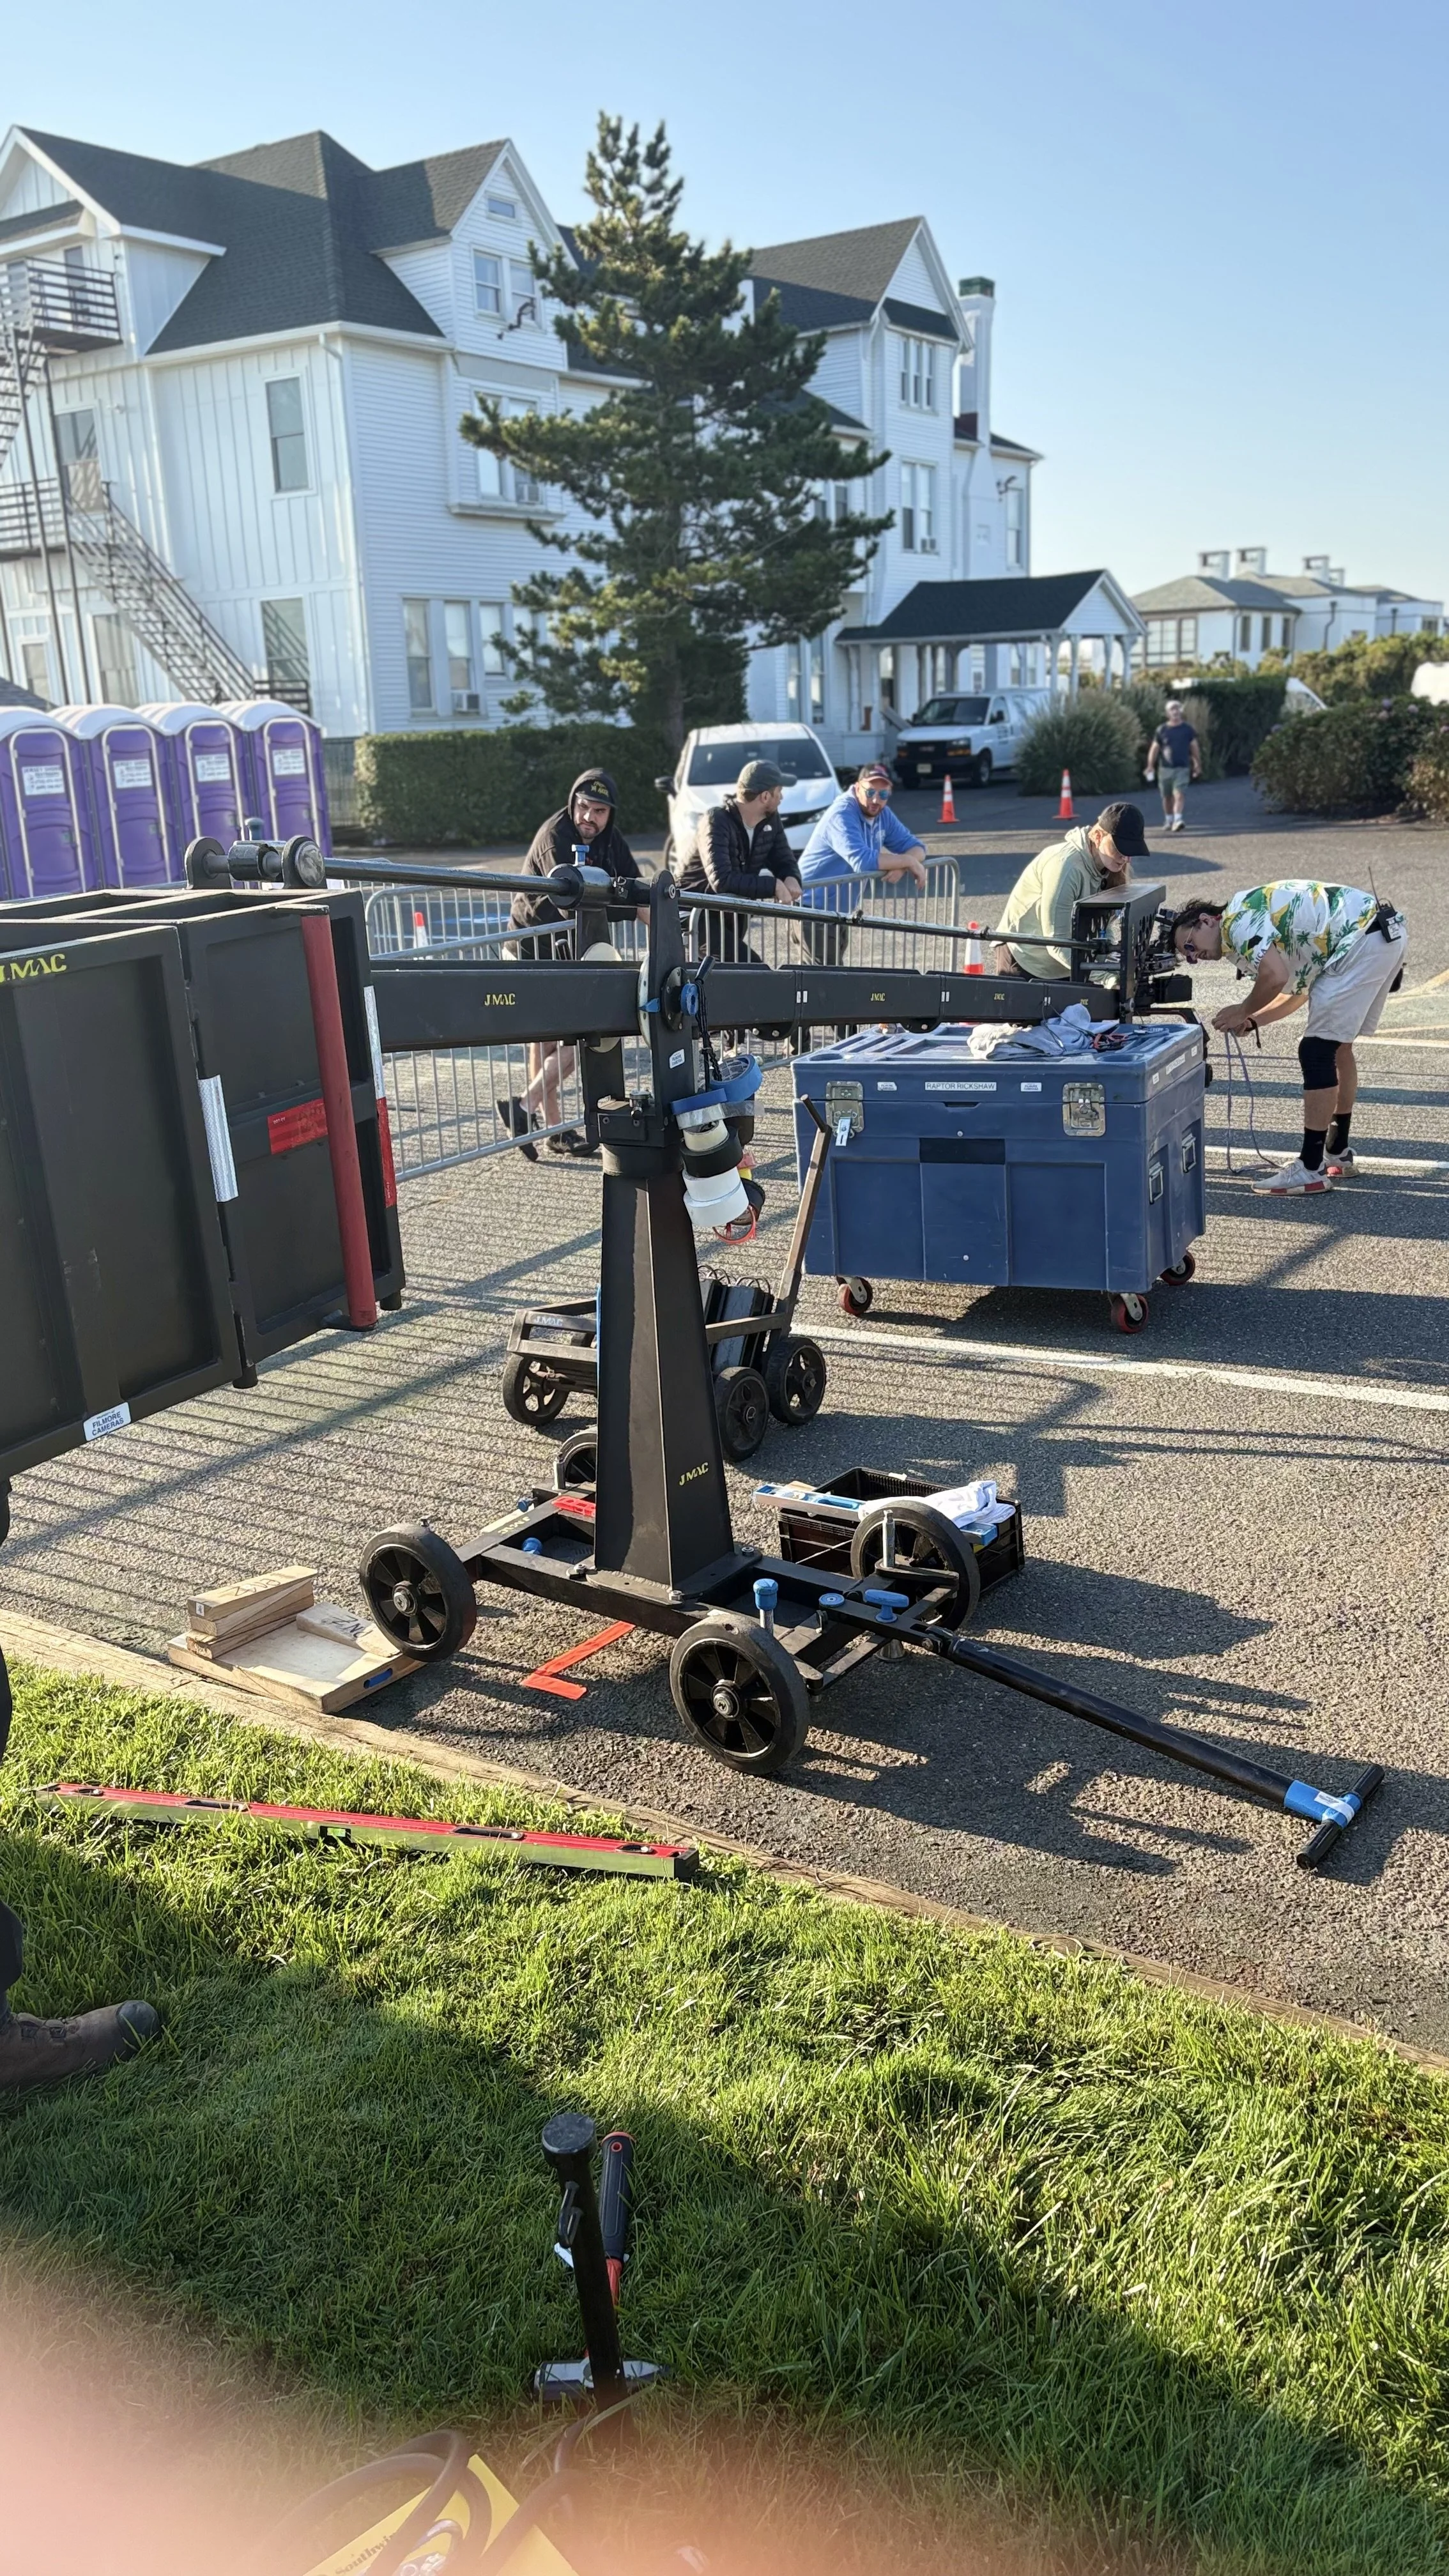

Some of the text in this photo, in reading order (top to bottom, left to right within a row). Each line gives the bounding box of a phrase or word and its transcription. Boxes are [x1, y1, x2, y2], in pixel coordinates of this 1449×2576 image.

[92, 1418, 124, 1436] CAMERAS
[93, 1411, 121, 1429] FILMORE
[335, 2534, 395, 2575] Southwi
